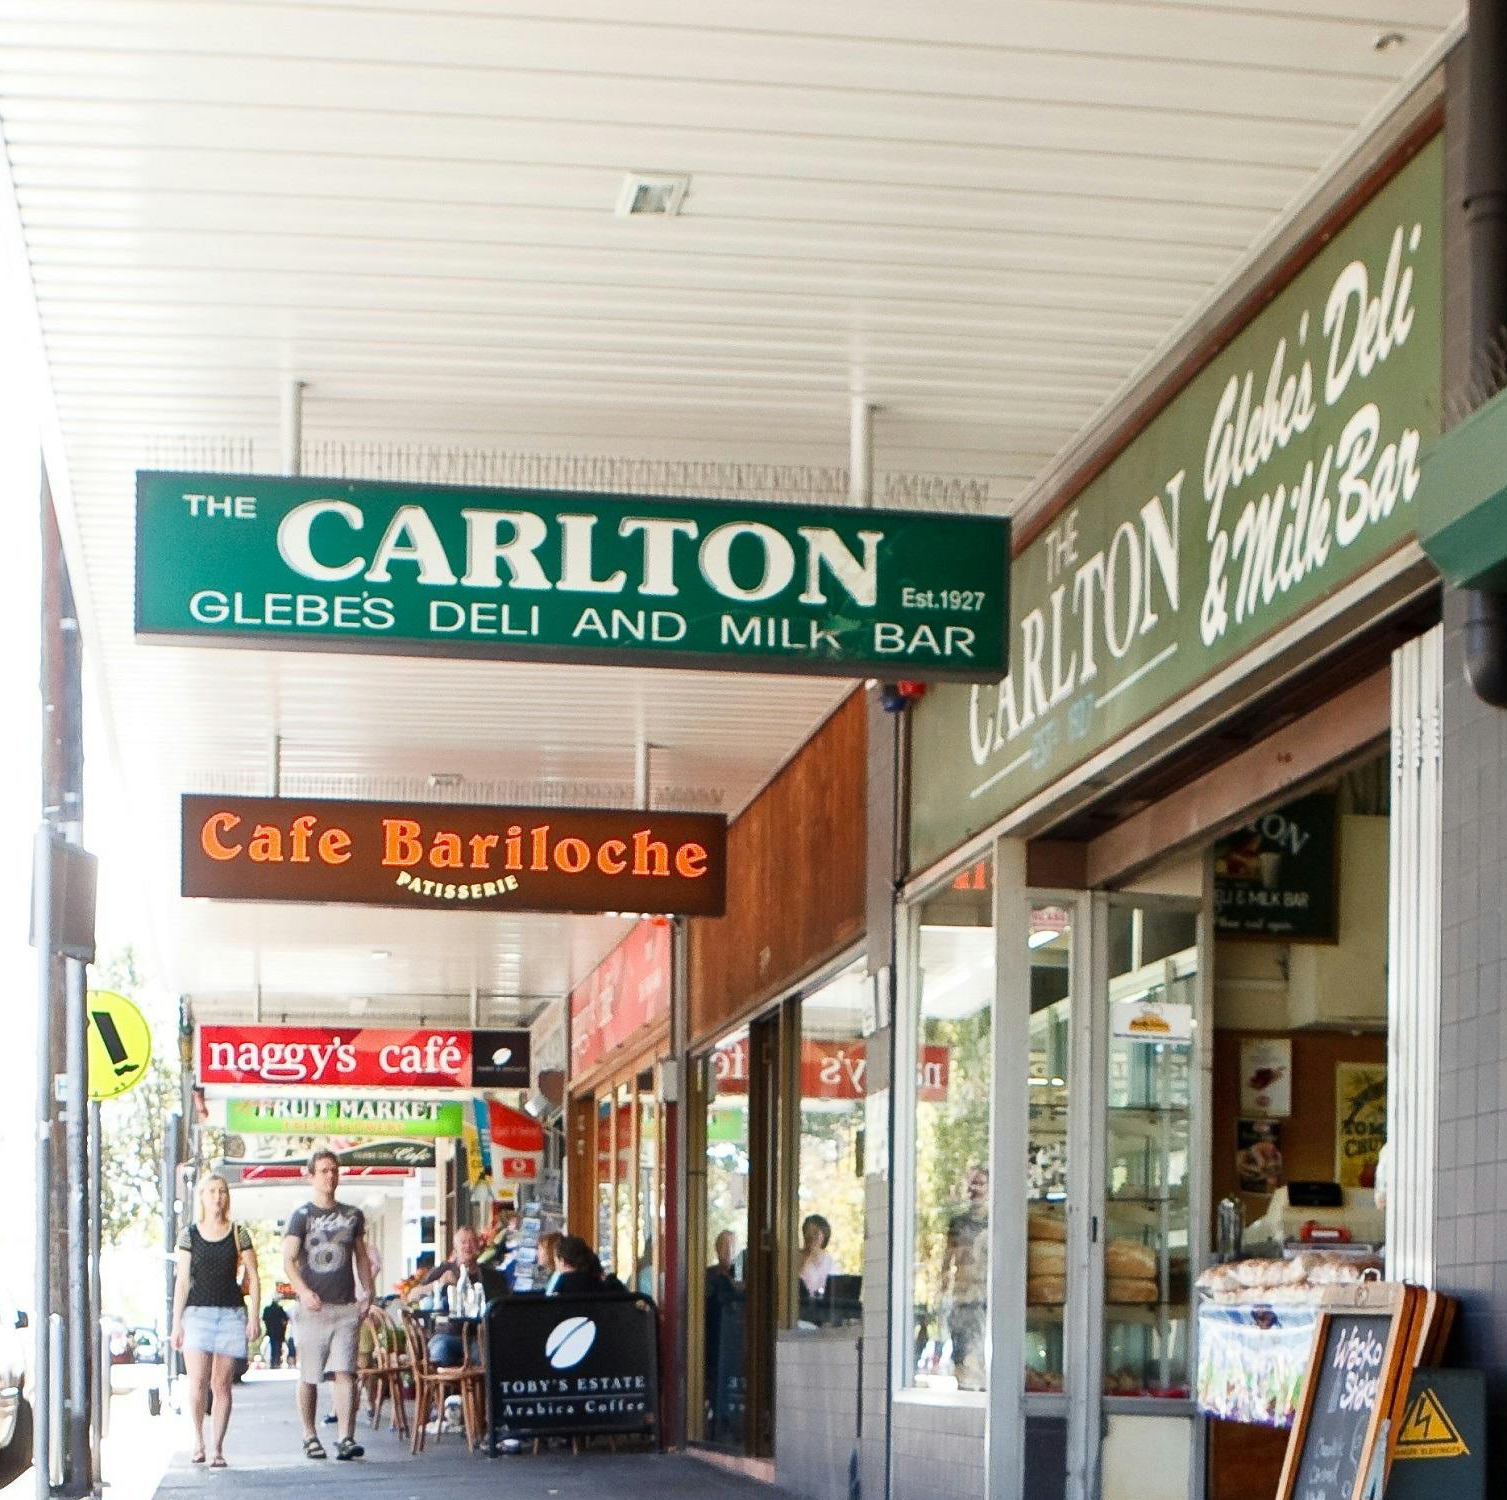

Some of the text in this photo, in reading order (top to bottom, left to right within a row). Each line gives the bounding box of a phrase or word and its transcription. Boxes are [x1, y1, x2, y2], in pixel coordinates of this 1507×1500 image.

[1322, 222, 1422, 406] Deli
[182, 492, 258, 521] THE
[1200, 402, 1421, 647] & Milk Bar
[276, 498, 886, 608] CARLTON
[1045, 506, 1079, 584] THE
[188, 589, 975, 659] GLEBE'S DELI AND MILK BAR
[900, 585, 986, 614] Est.1927
[969, 469, 1186, 767] CARLTON
[200, 811, 709, 880] Cafe Bariloche
[394, 870, 520, 900] PATISSERIE
[208, 1035, 463, 1081] naggy's café
[254, 1100, 338, 1119] FRUIT
[340, 1101, 442, 1121] MARKET
[500, 1375, 646, 1395] TOBY'S ESTATE
[503, 1398, 646, 1418] Arabica Coffee
